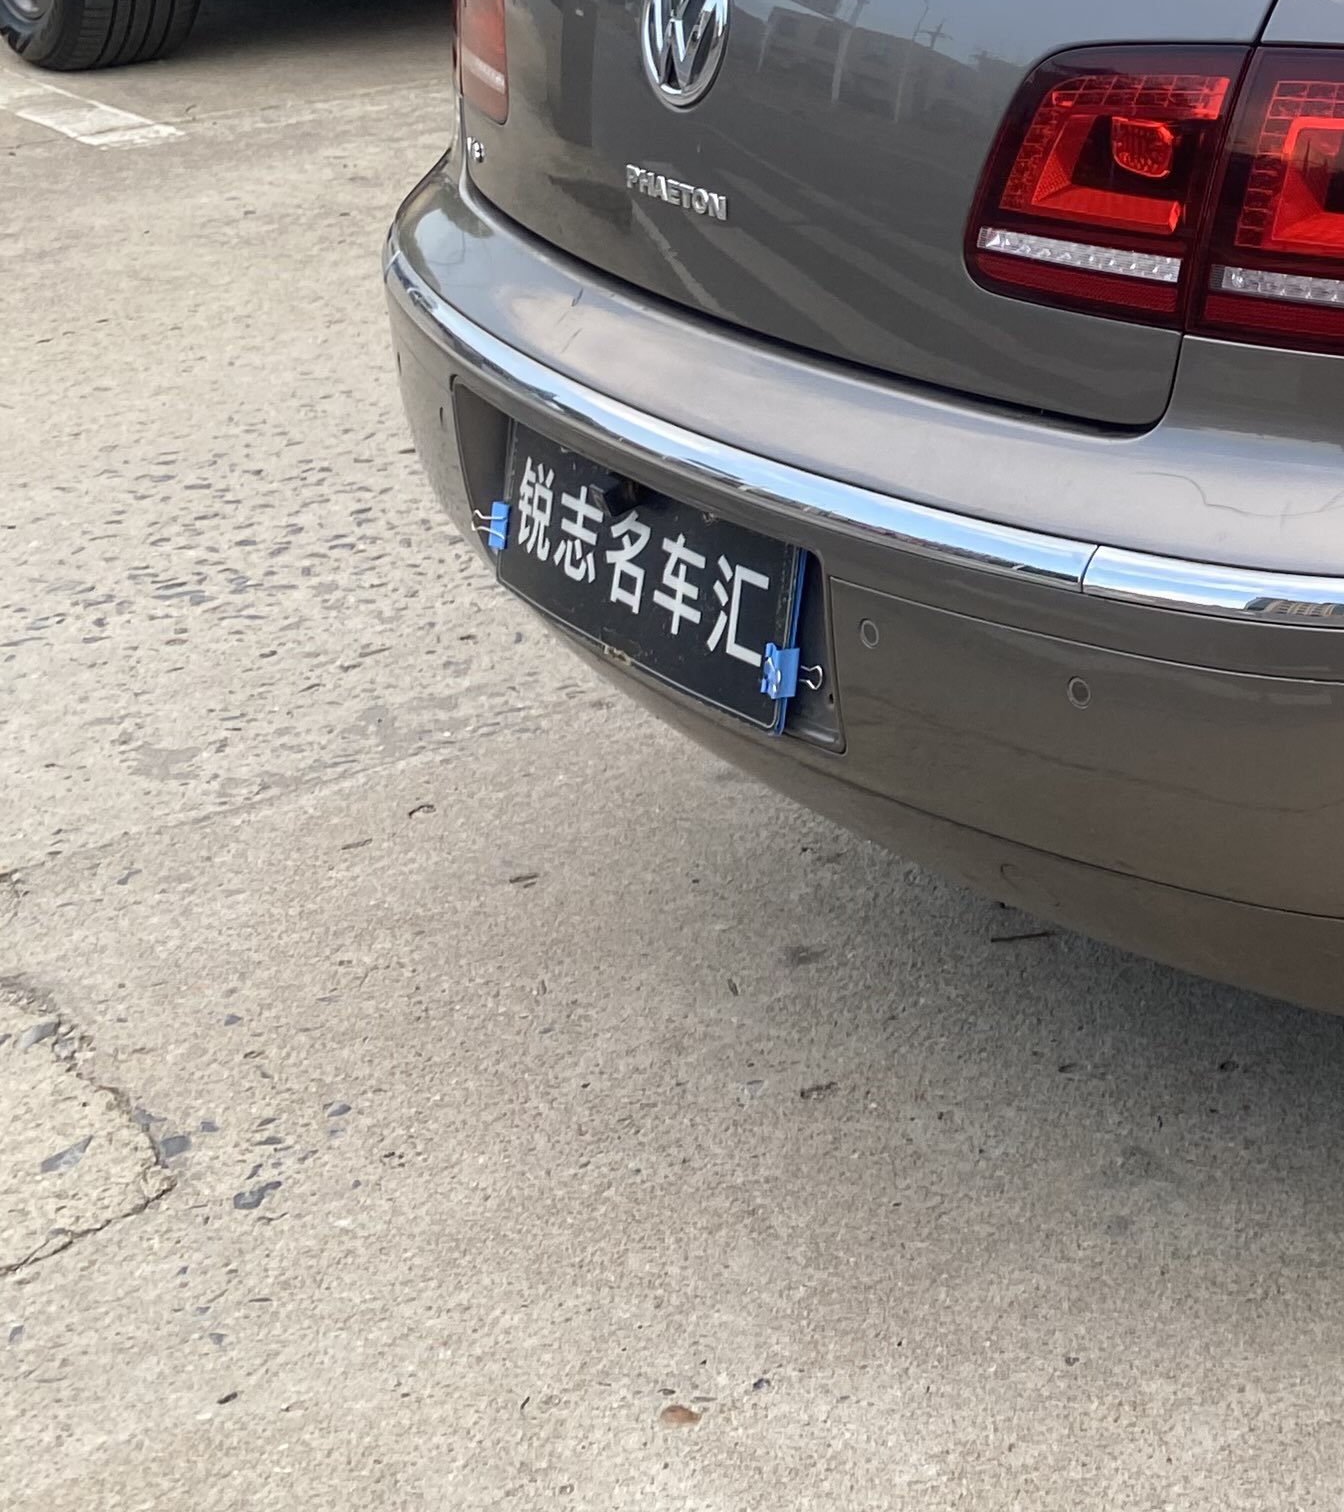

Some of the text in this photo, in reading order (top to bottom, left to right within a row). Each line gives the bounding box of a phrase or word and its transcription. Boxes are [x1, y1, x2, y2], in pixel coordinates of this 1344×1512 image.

[626, 164, 727, 221] PHAETON
[517, 456, 770, 667] 锐志名车汇
